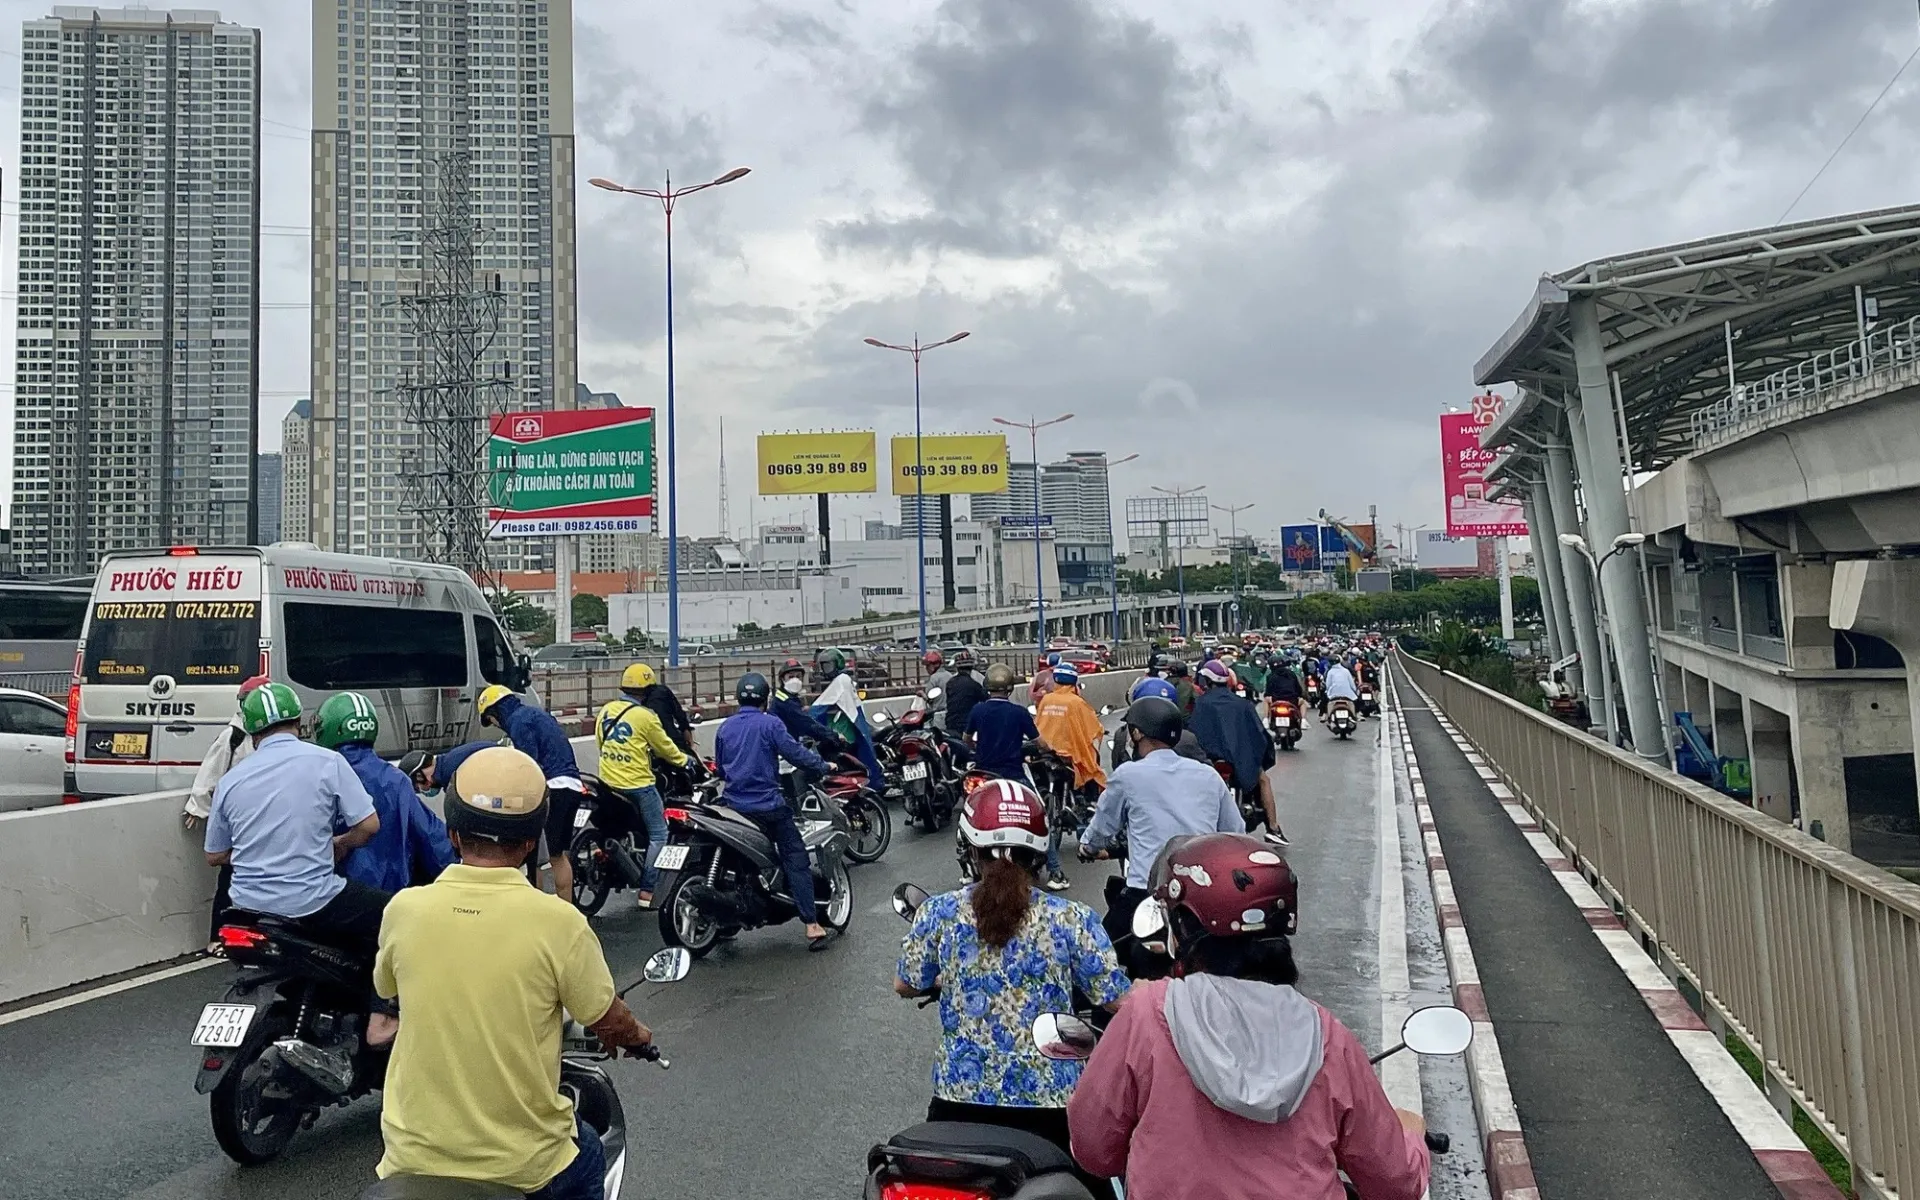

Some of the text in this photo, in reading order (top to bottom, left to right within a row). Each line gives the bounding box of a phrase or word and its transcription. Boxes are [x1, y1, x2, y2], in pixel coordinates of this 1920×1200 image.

[537, 451, 558, 469] LÀN,
[561, 450, 587, 467] DỪNG
[589, 449, 616, 466] ĐÚNG
[618, 450, 644, 469] VẠCH
[1460, 447, 1479, 461] BẾP
[768, 462, 867, 476] 0969.39.89.89
[506, 470, 635, 492] GỮ KHOẢNG CÁCH AN TOÀN
[501, 520, 638, 533] Please Call: 0982.456.686
[1286, 544, 1315, 565] Tiger
[110, 565, 242, 591] PHƯỚC HIẾU
[97, 603, 255, 619] 0773.772.772 0774.772.772
[346, 718, 376, 732] Grab
[1007, 803, 1031, 812] YAMAHA
[207, 1008, 245, 1025] 77-C1
[196, 1025, 242, 1043] 729.01
